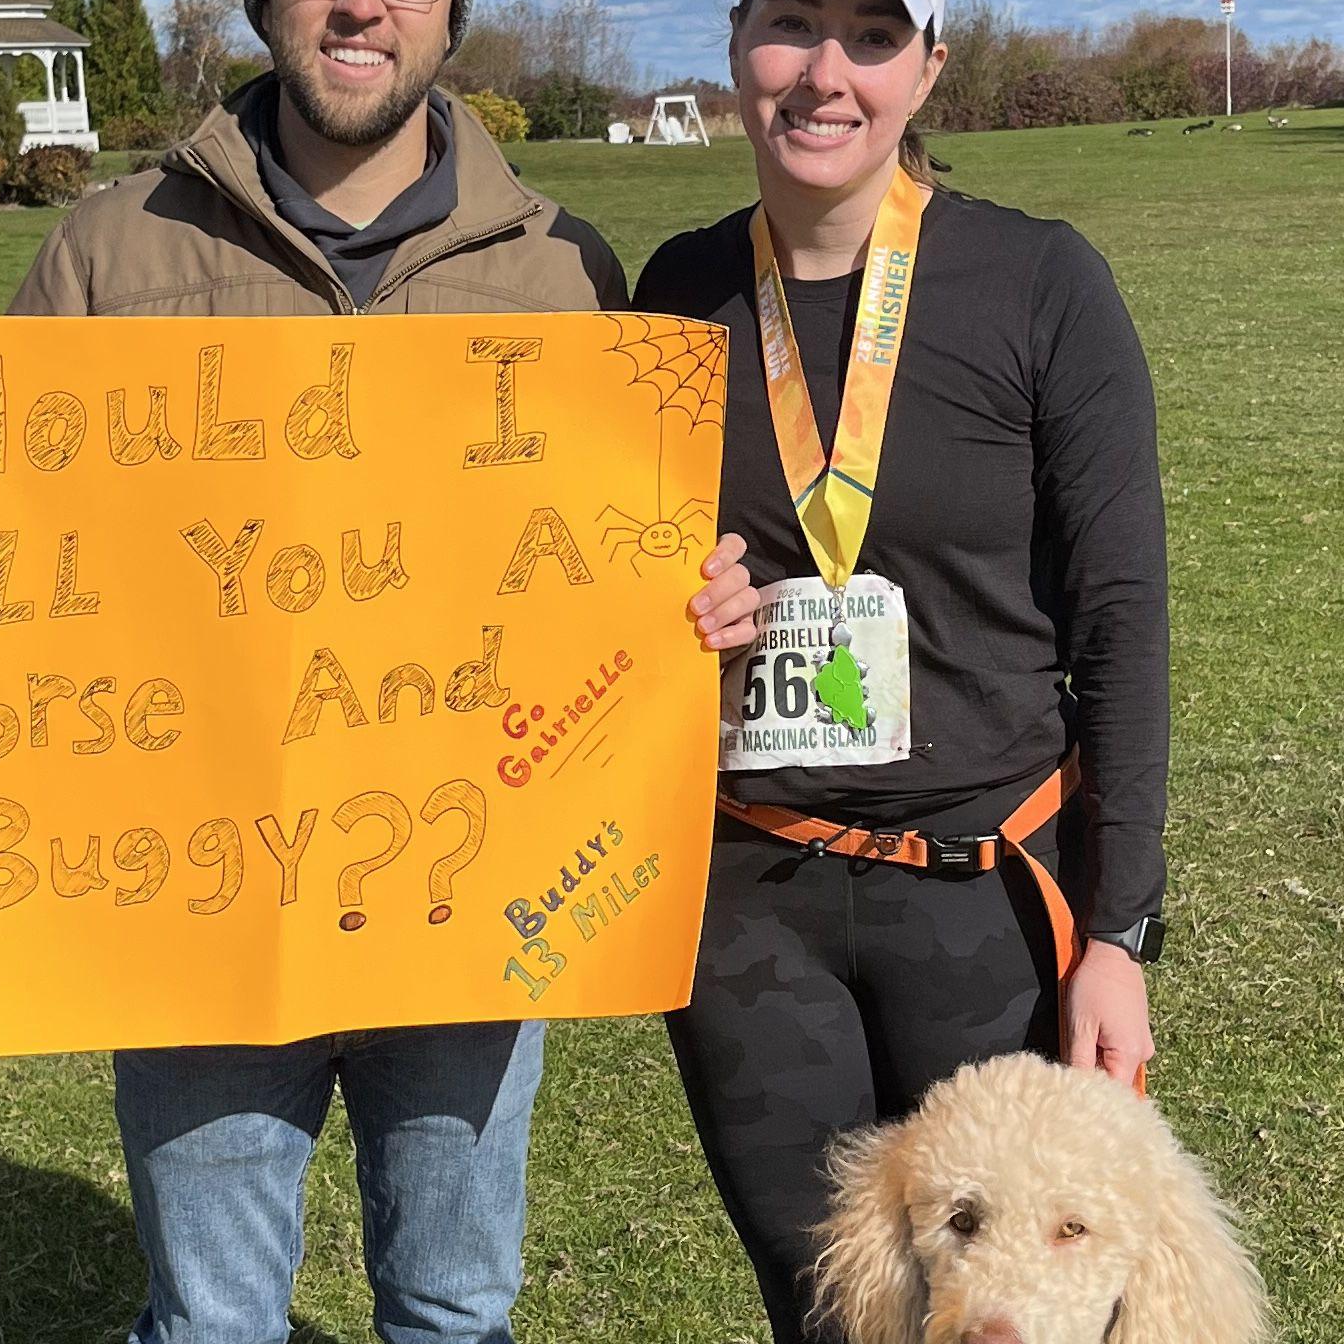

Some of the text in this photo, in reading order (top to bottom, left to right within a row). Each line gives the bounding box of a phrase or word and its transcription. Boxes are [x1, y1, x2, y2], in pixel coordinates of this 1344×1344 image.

[864, 246, 888, 313] ANNUAL
[872, 251, 910, 366] FINISHER
[765, 339, 783, 381] RUN
[462, 336, 548, 469] I
[179, 518, 410, 618] You
[496, 506, 594, 595] A
[776, 587, 803, 599] 2024
[846, 595, 886, 619] RACE
[282, 625, 513, 745] And
[741, 651, 830, 722] 56
[502, 703, 545, 739] Go
[742, 726, 877, 753] MACKINAC ISLAND
[503, 937, 568, 1002] 13
